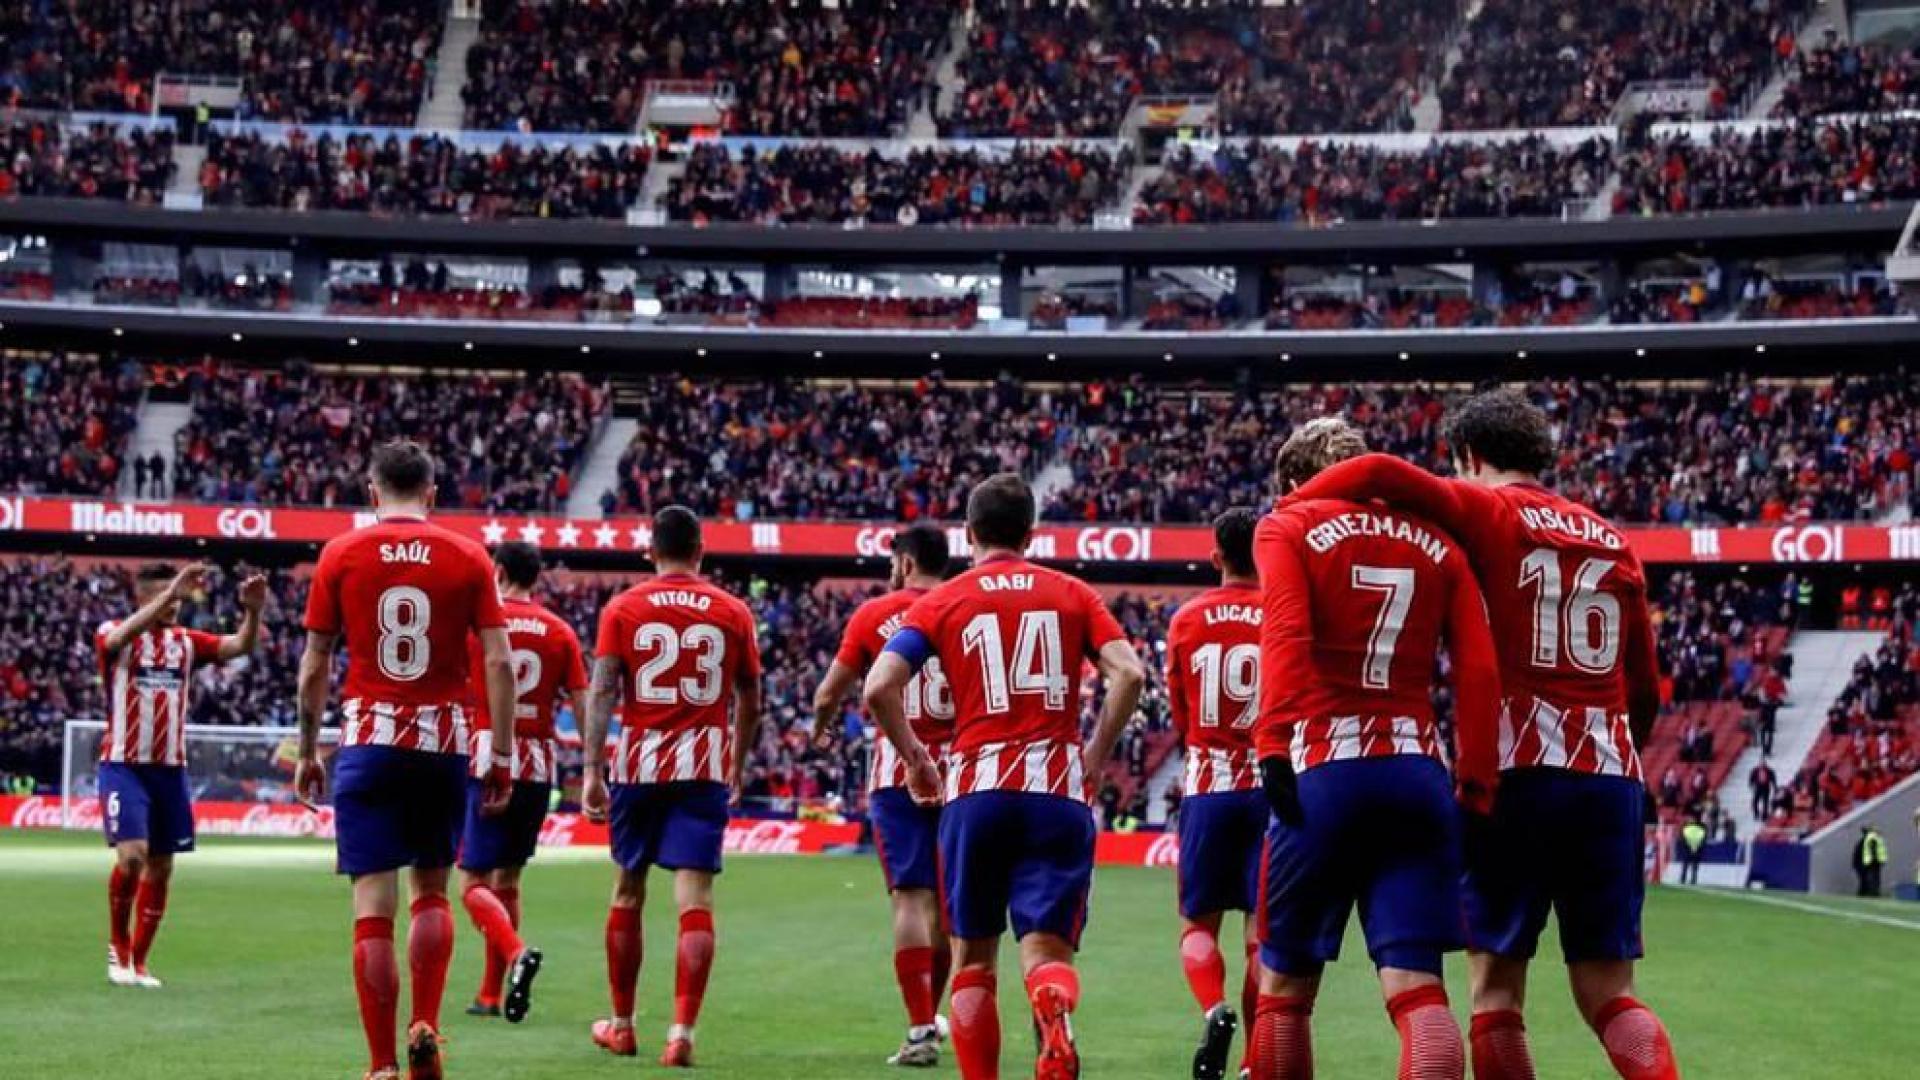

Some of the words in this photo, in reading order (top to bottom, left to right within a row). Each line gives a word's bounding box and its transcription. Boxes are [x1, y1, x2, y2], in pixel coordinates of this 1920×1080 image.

[71, 501, 184, 535] Mahou
[216, 507, 277, 539] GOL
[1304, 513, 1449, 564] GRIEZMANN
[380, 540, 432, 564] SAÚL
[647, 590, 711, 611] VITOLO
[979, 573, 1034, 591] GABI
[1517, 548, 1621, 674] 16
[378, 586, 431, 681] 8
[1204, 604, 1263, 626] LUCAS
[1351, 565, 1416, 690] 7
[512, 648, 541, 718] 2
[633, 622, 726, 706] 23
[903, 655, 956, 721] 18
[961, 610, 1069, 715] 14
[1190, 643, 1262, 729] 19
[108, 791, 121, 817] 6
